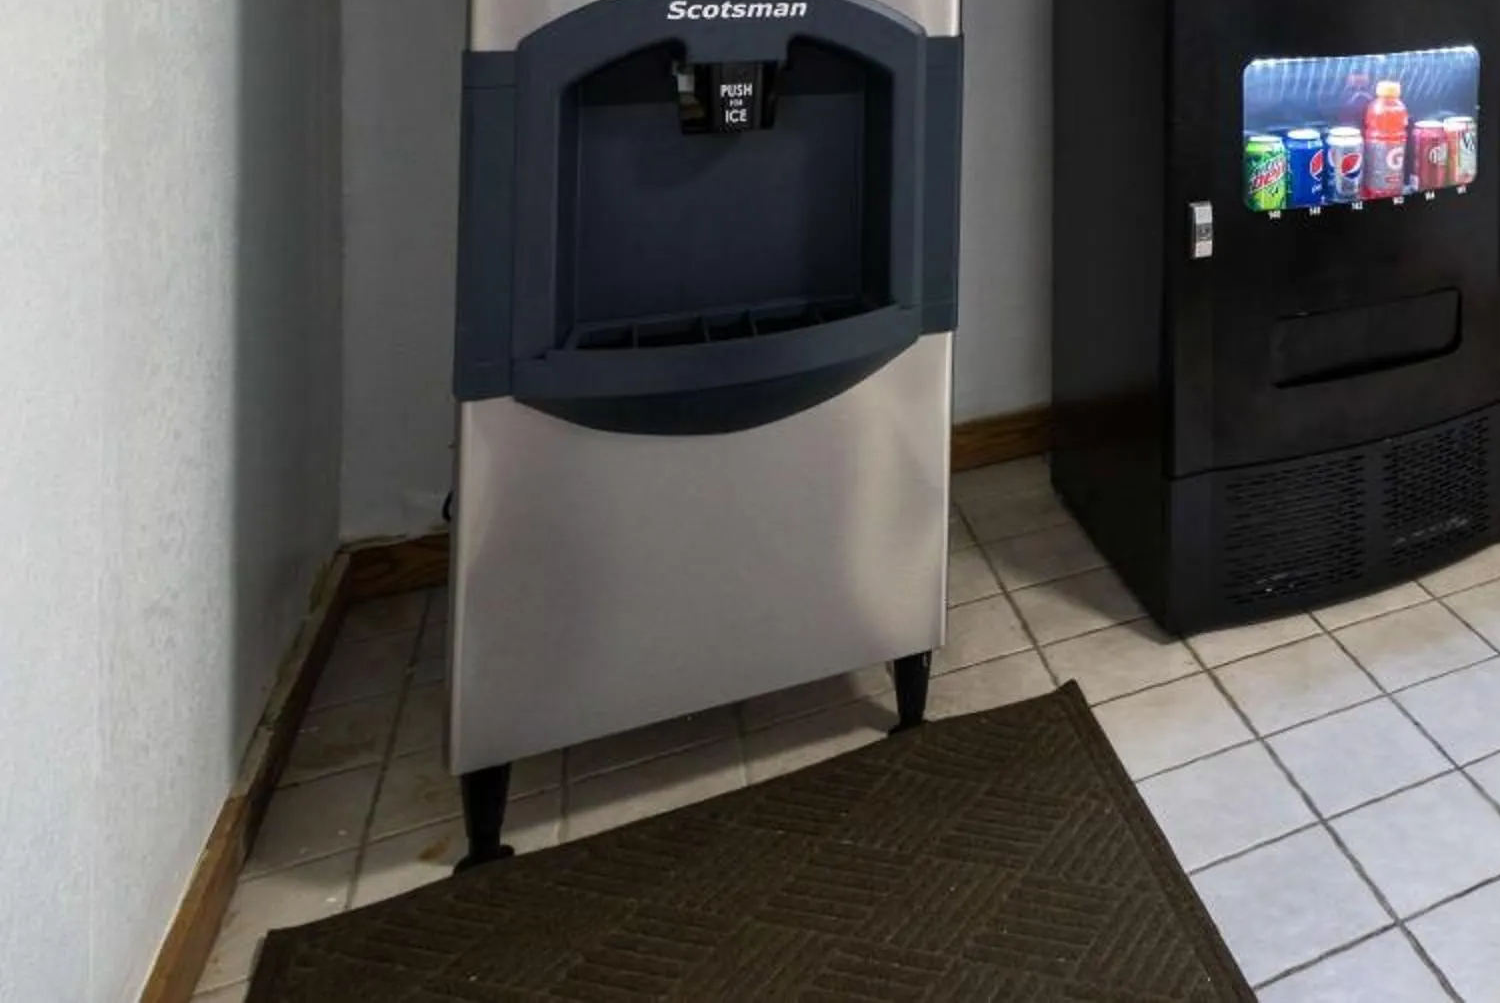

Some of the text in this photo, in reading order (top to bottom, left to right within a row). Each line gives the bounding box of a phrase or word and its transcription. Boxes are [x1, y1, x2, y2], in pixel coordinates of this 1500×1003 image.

[666, 0, 807, 20] Scotsman
[720, 84, 753, 97] PUSH
[725, 109, 747, 123] ICE
